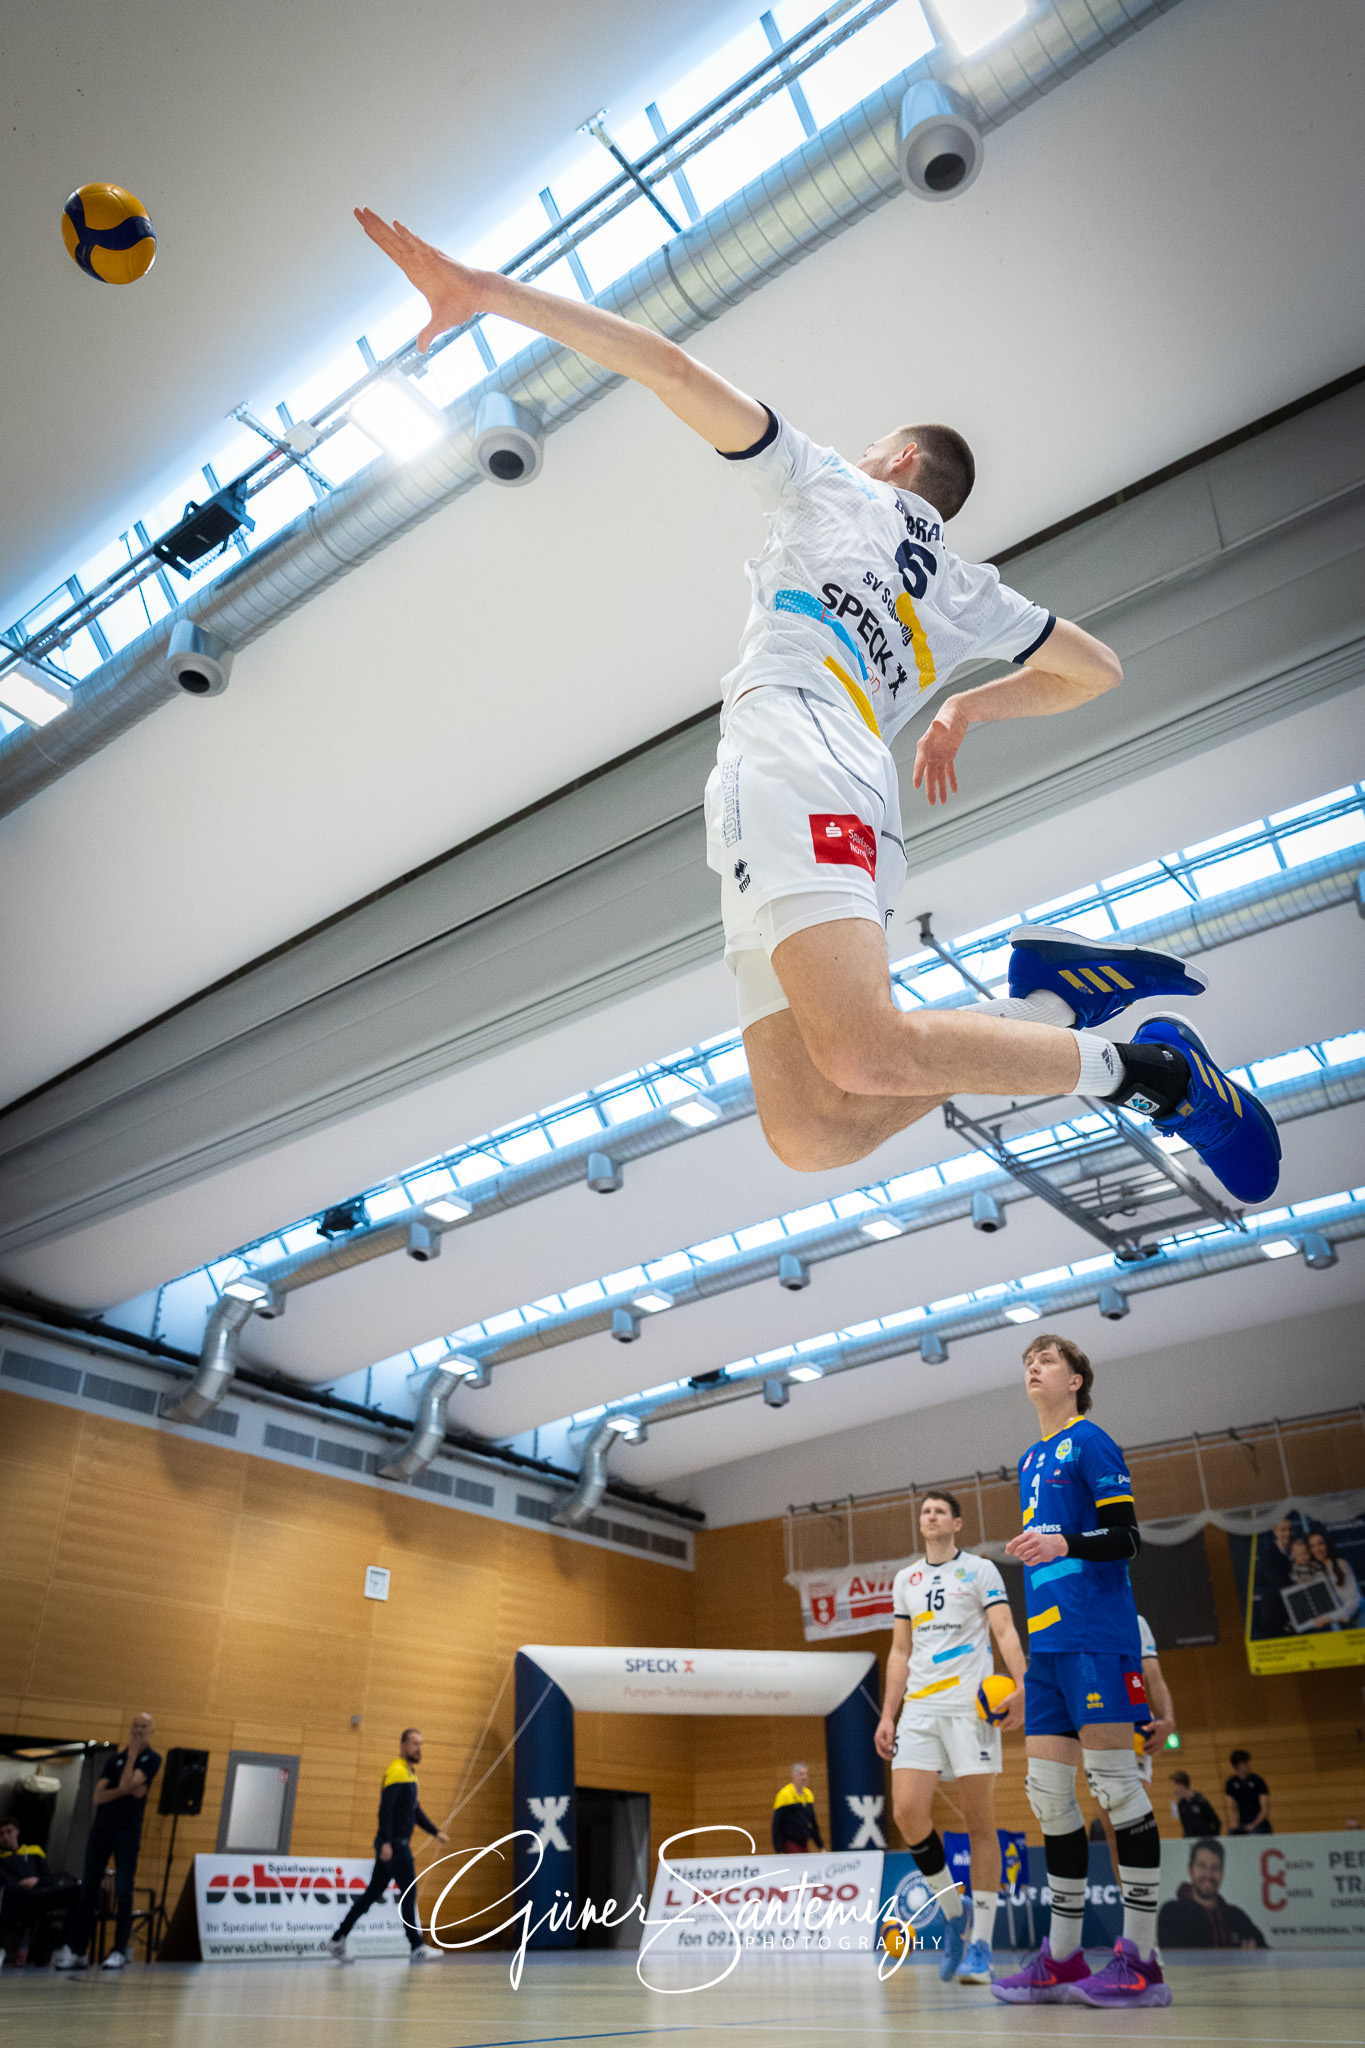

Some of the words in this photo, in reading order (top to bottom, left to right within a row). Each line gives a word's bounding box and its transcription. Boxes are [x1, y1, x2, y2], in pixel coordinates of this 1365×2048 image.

[895, 538, 937, 600] 6
[863, 571, 883, 591] SV
[817, 583, 894, 677] SPECK
[848, 829, 875, 858] Sparkasse
[925, 1588, 945, 1611] 15
[625, 1658, 678, 1673] SPECK
[267, 1862, 335, 1874] Spielwaren
[669, 1865, 760, 1881] Ristorante
[678, 1930, 701, 1946] fon
